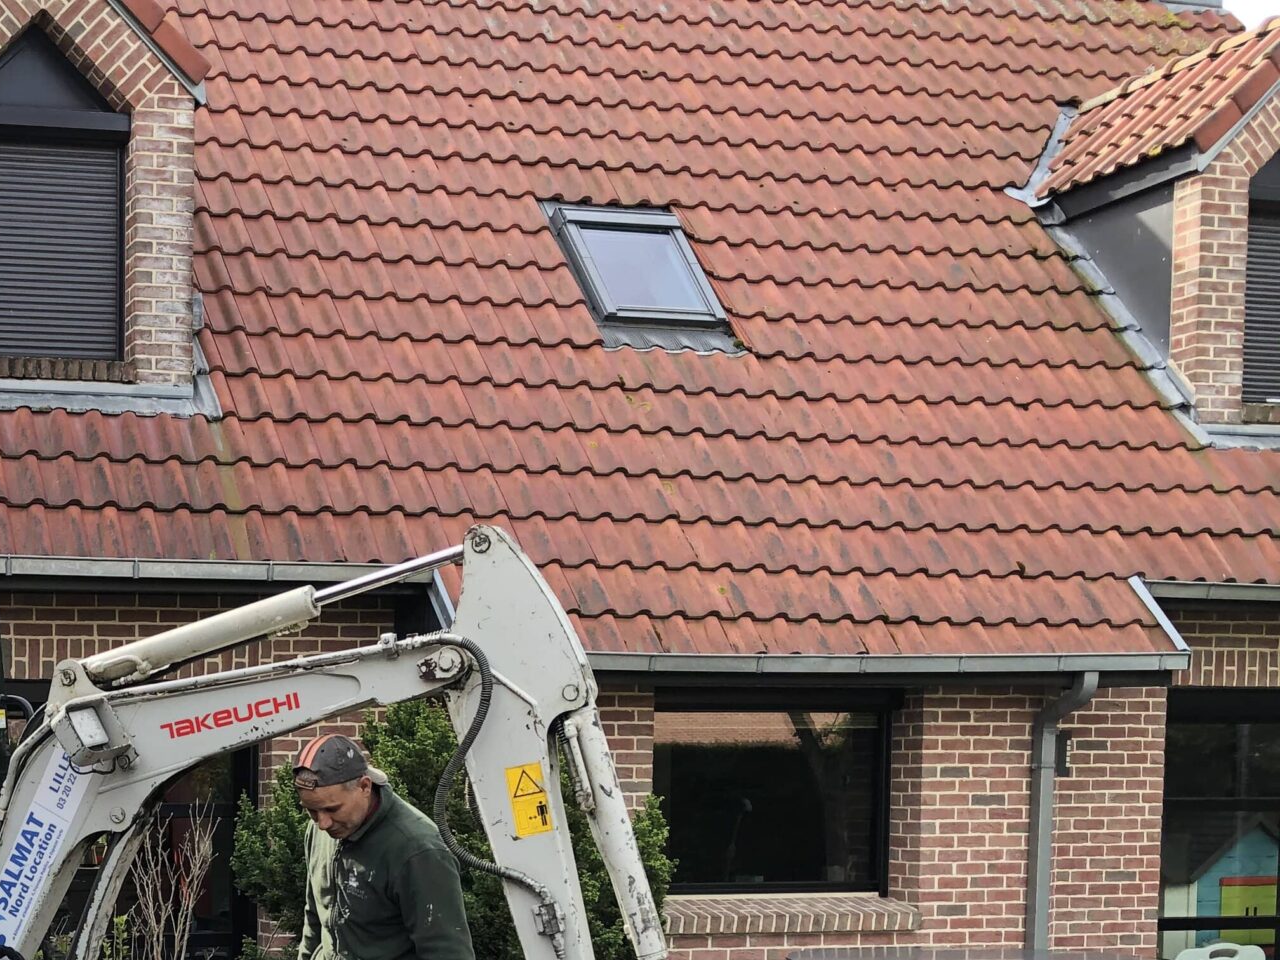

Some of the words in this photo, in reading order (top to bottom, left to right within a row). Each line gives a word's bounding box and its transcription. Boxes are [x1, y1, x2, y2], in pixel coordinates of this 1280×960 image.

[56, 797, 67, 810] 03
[62, 785, 72, 798] 20
[67, 773, 77, 785] 22
[8, 882, 30, 918] Nord
[24, 823, 57, 882] Location
